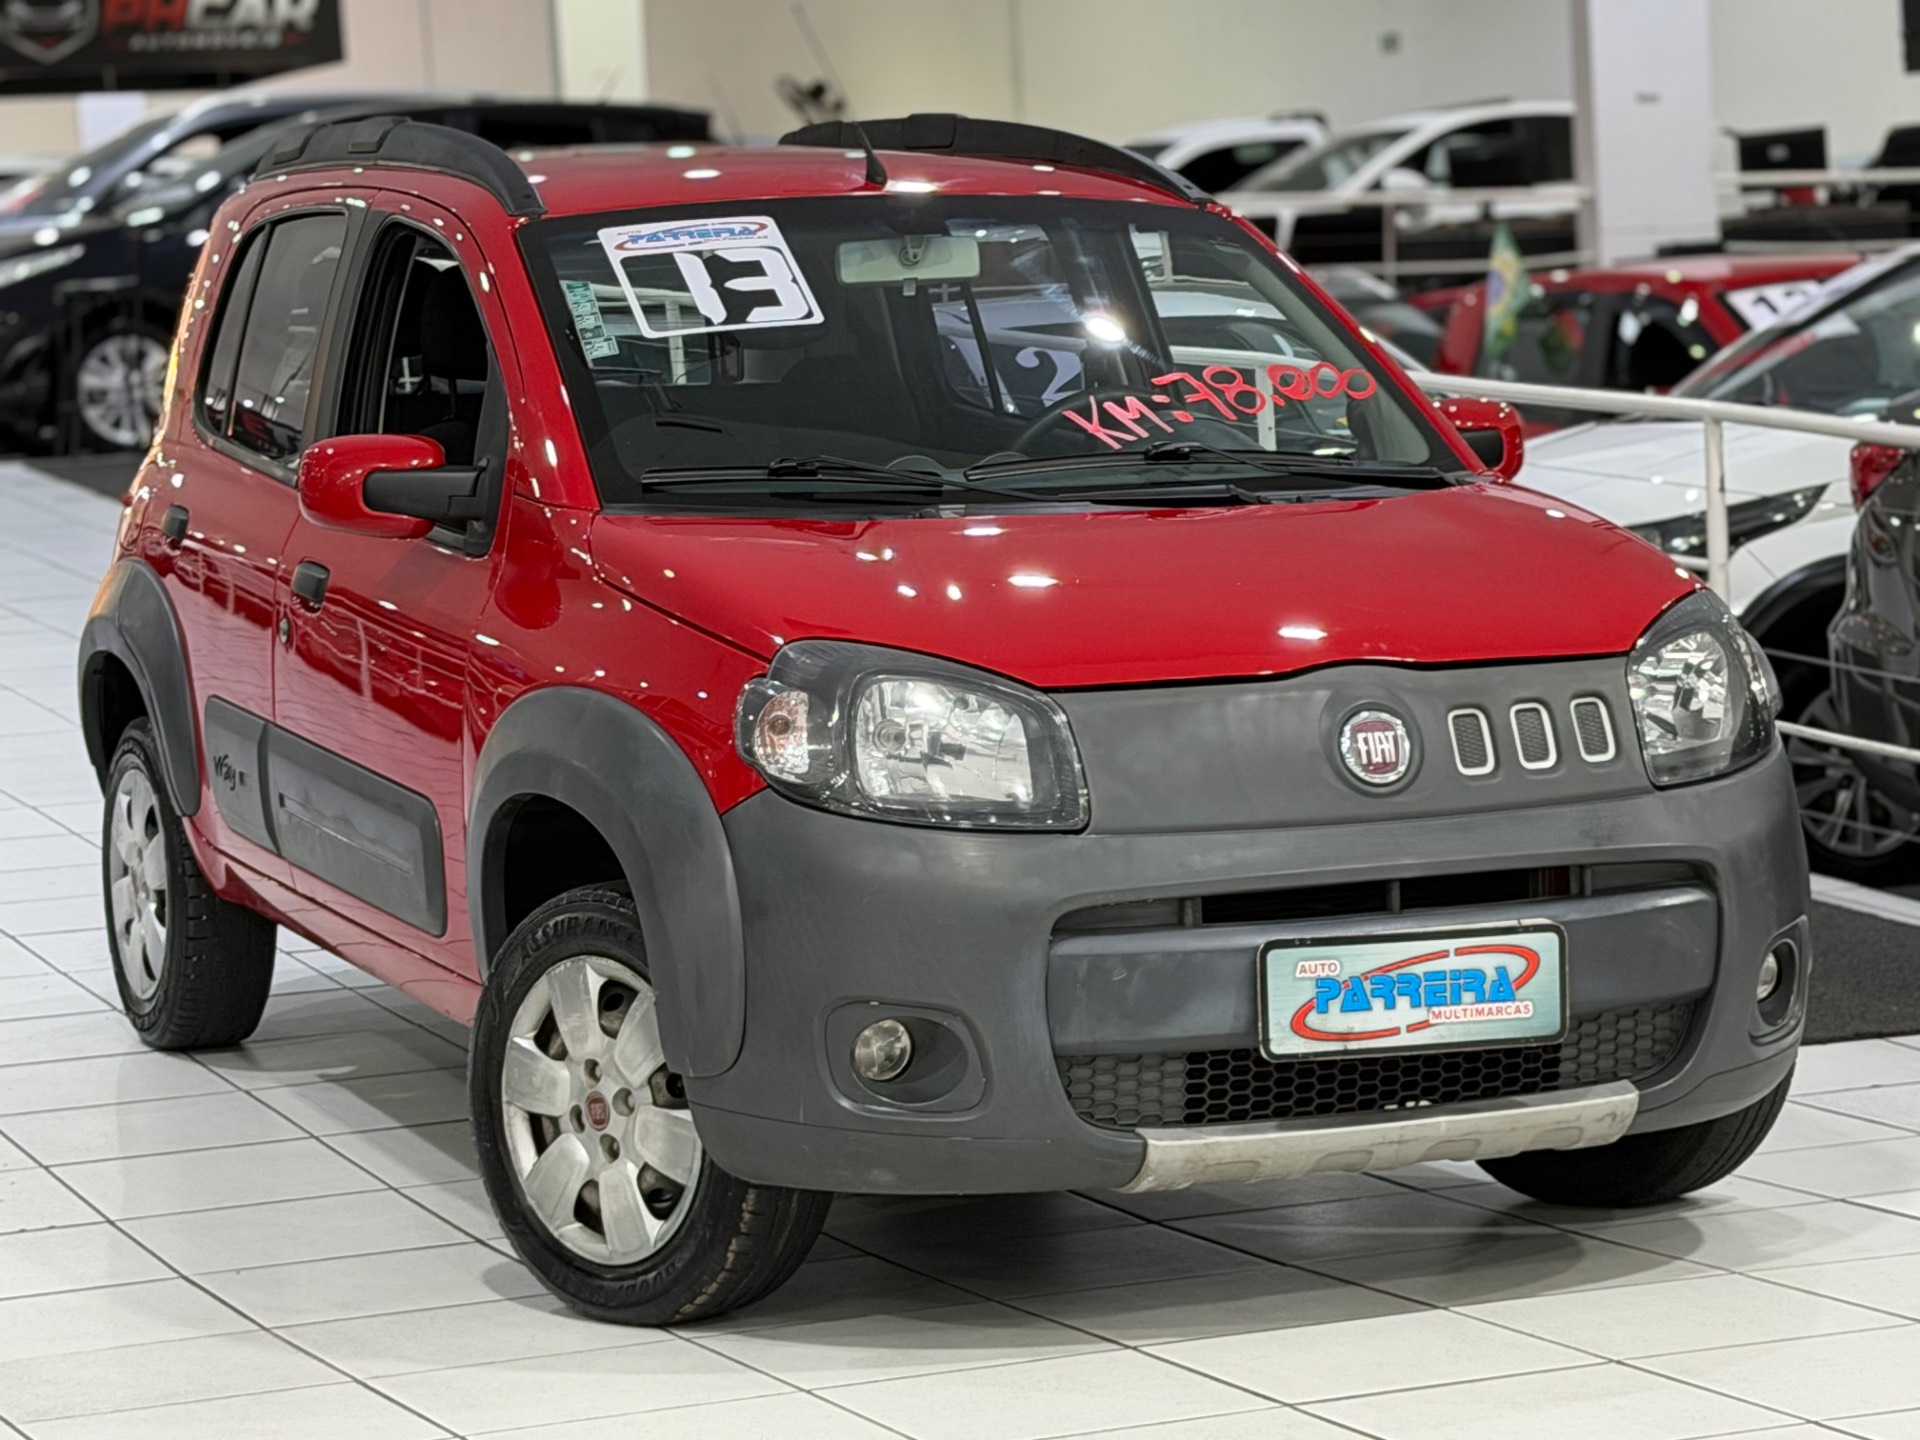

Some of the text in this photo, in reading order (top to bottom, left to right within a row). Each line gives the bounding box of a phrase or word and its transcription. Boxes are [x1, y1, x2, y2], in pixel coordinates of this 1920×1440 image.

[628, 226, 757, 244] PARREIRA
[1356, 730, 1397, 765] FIAT
[213, 754, 237, 791] Way
[1298, 962, 1339, 976] AUTO
[1315, 966, 1516, 1014] PARREIRA
[1431, 1003, 1532, 1021] MULTIMARCAS
